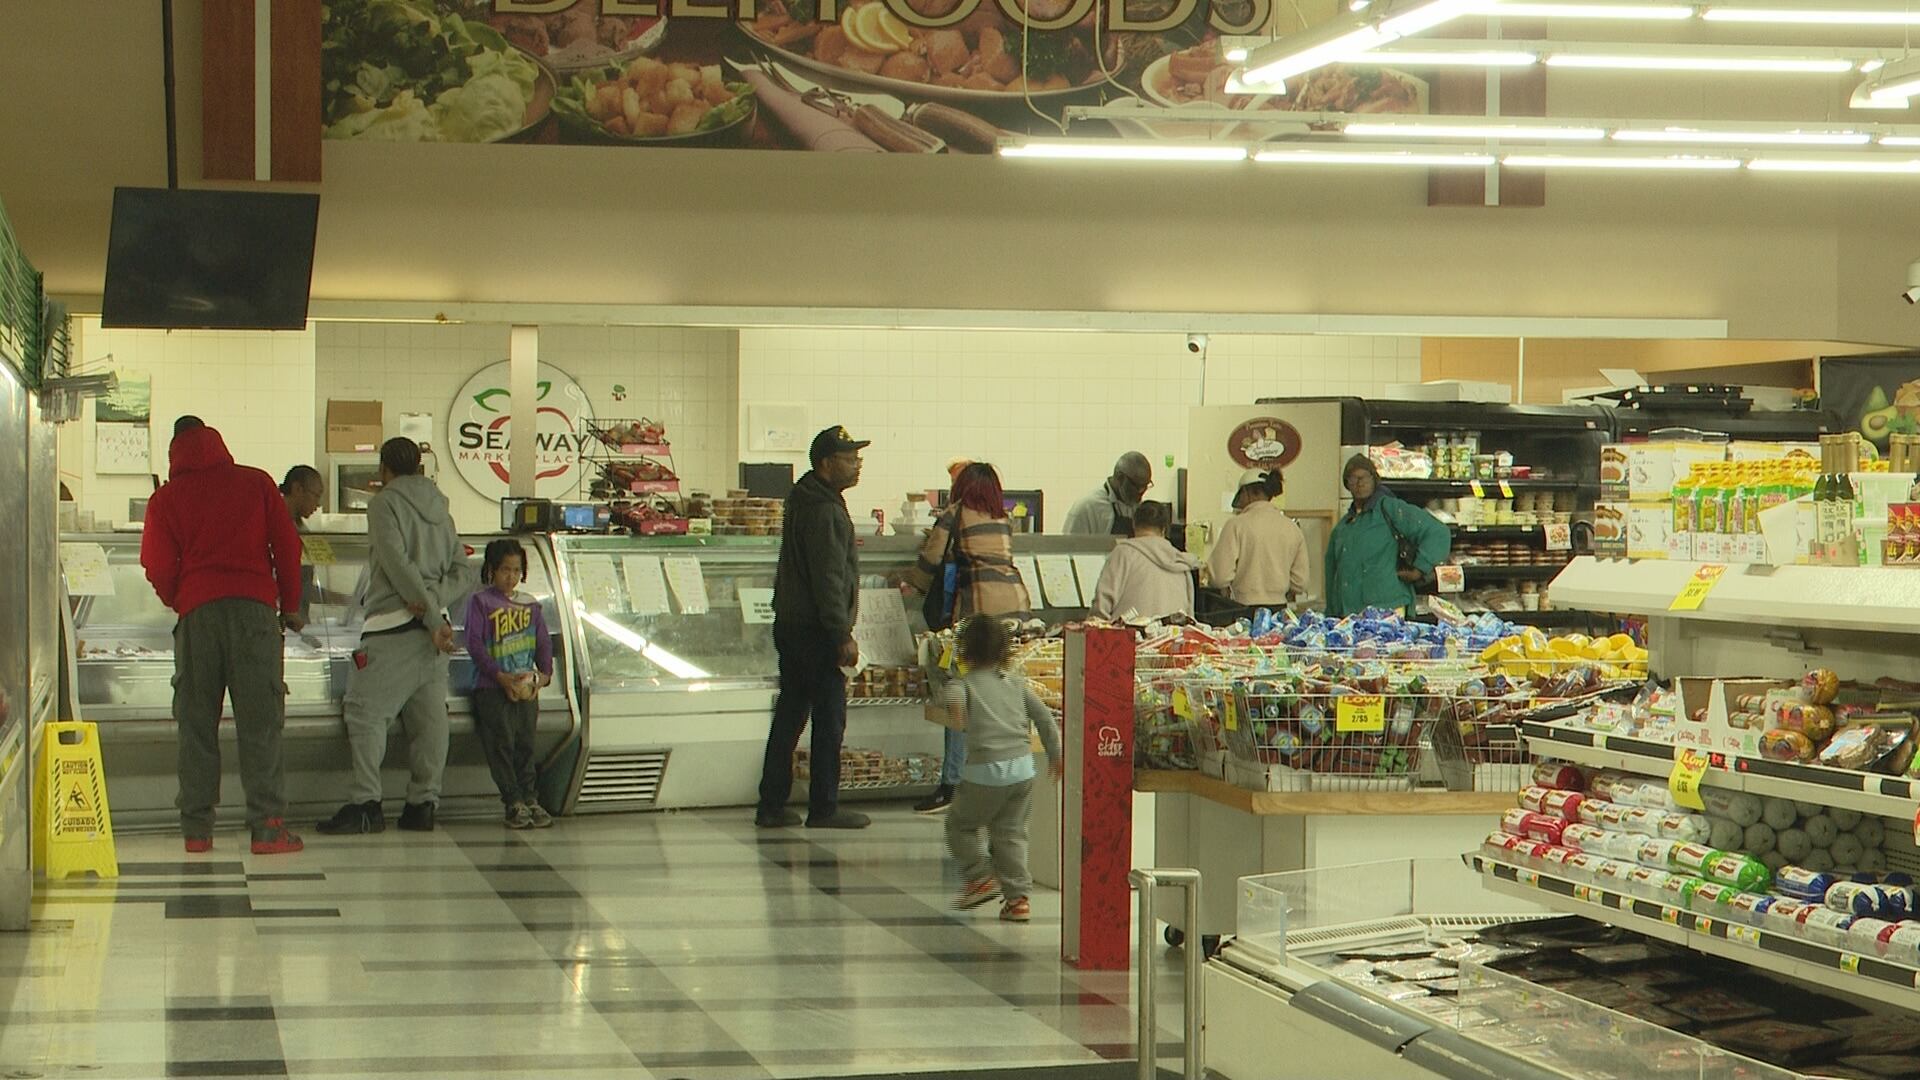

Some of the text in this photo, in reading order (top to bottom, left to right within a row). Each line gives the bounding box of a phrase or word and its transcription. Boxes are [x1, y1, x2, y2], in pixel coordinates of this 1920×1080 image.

[459, 422, 588, 452] SEWAY
[1343, 695, 1380, 704] LOW
[62, 760, 88, 769] CAUTION
[1682, 752, 1707, 769] LOW
[62, 817, 96, 826] CUIDADO
